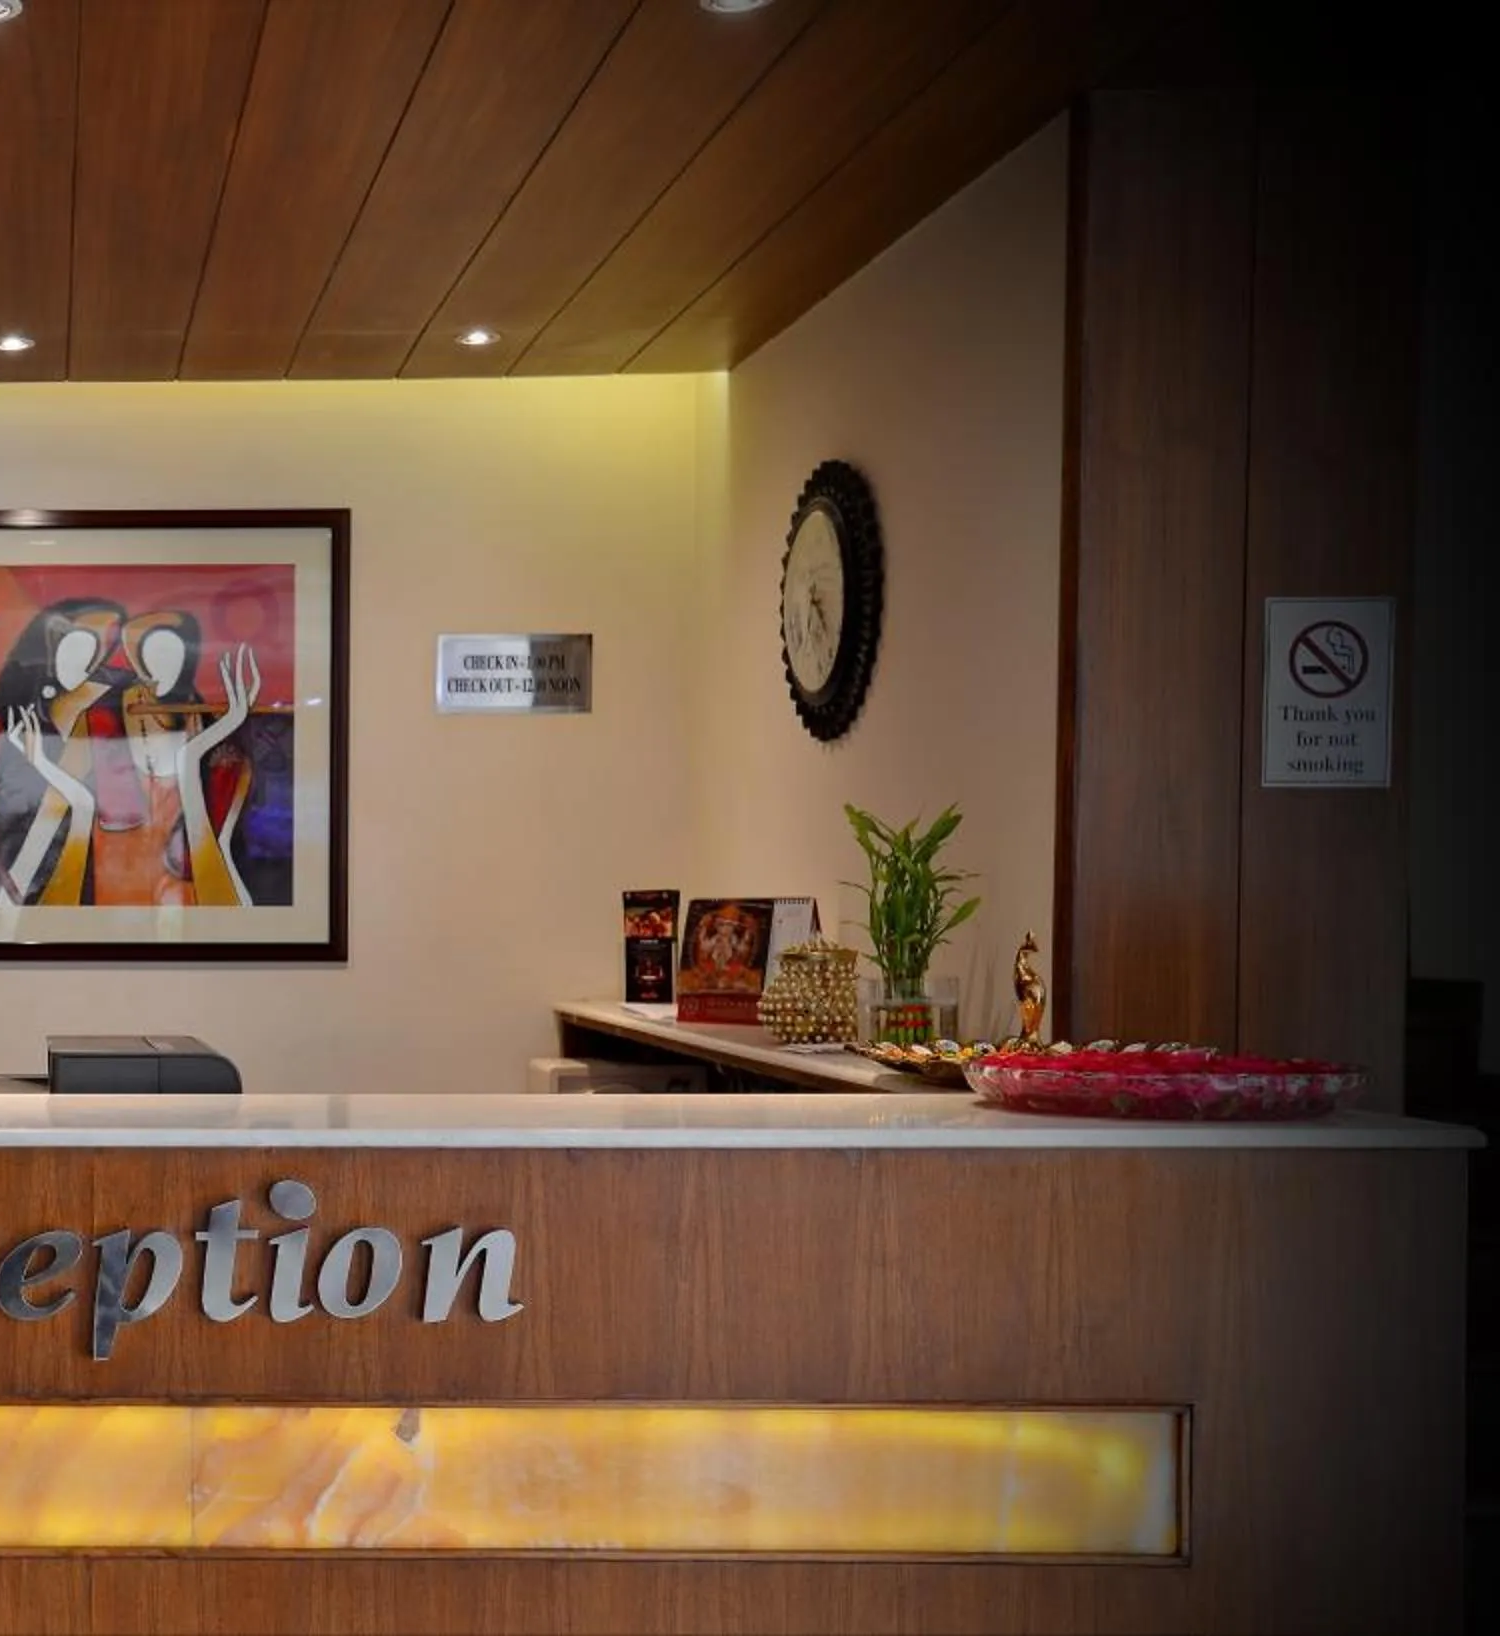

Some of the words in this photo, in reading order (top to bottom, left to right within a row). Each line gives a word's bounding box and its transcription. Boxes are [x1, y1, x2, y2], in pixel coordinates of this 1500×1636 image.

[464, 654, 503, 671] CHECK
[505, 654, 519, 671] IN
[527, 654, 547, 671] 100
[548, 654, 566, 671] PM
[447, 677, 487, 694] CHECK
[489, 677, 512, 694] OUT
[548, 676, 582, 694] NOON
[1278, 704, 1339, 722] Thank
[1343, 708, 1376, 726] you
[1296, 729, 1323, 747] for
[1328, 732, 1359, 748] not
[1287, 754, 1365, 777] smoking
